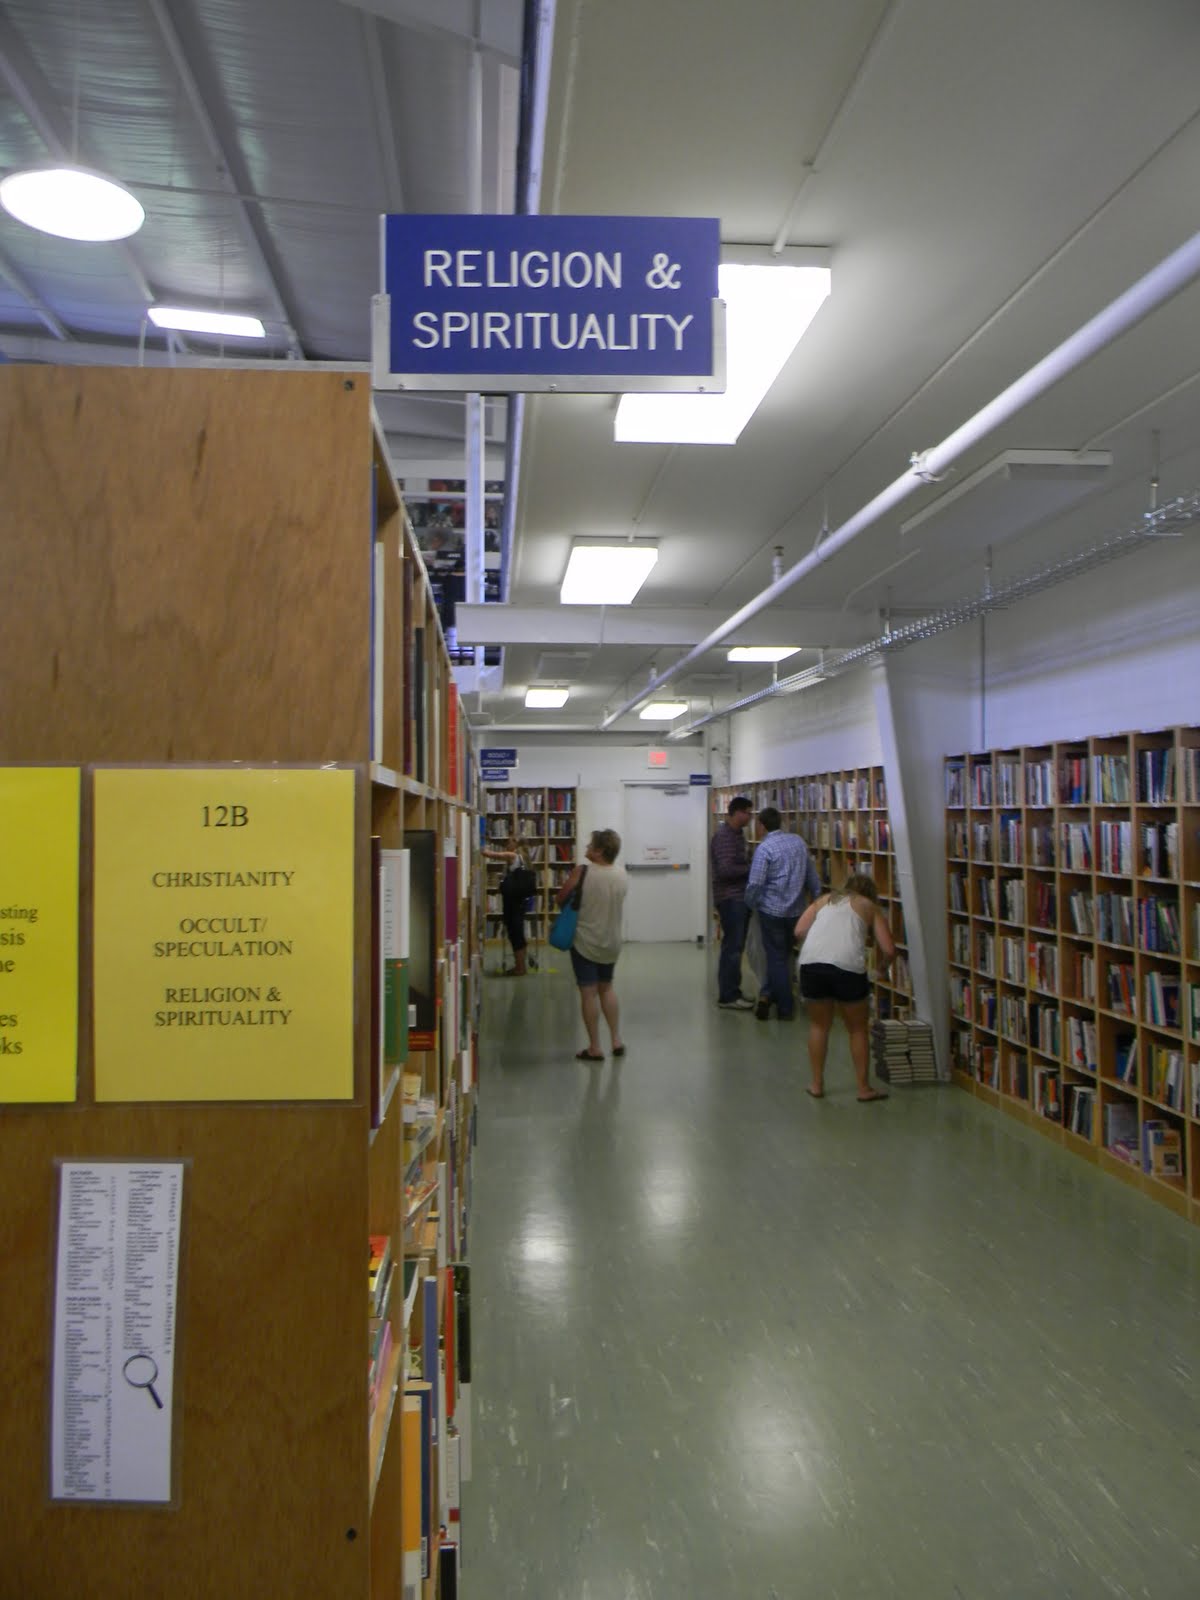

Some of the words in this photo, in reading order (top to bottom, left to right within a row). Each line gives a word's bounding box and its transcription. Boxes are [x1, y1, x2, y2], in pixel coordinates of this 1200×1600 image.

[424, 249, 622, 289] RELIGION
[645, 252, 682, 290] &
[412, 311, 694, 351] SPIRITUALITY
[202, 805, 249, 828] 12B
[151, 871, 295, 888] CHRISTIANITY
[179, 917, 269, 934] OCCULT/
[153, 940, 294, 958] SPECULATION
[164, 987, 261, 1004] RELIGION
[266, 987, 282, 1003] &
[154, 1009, 293, 1028] SPIRITUALITY
